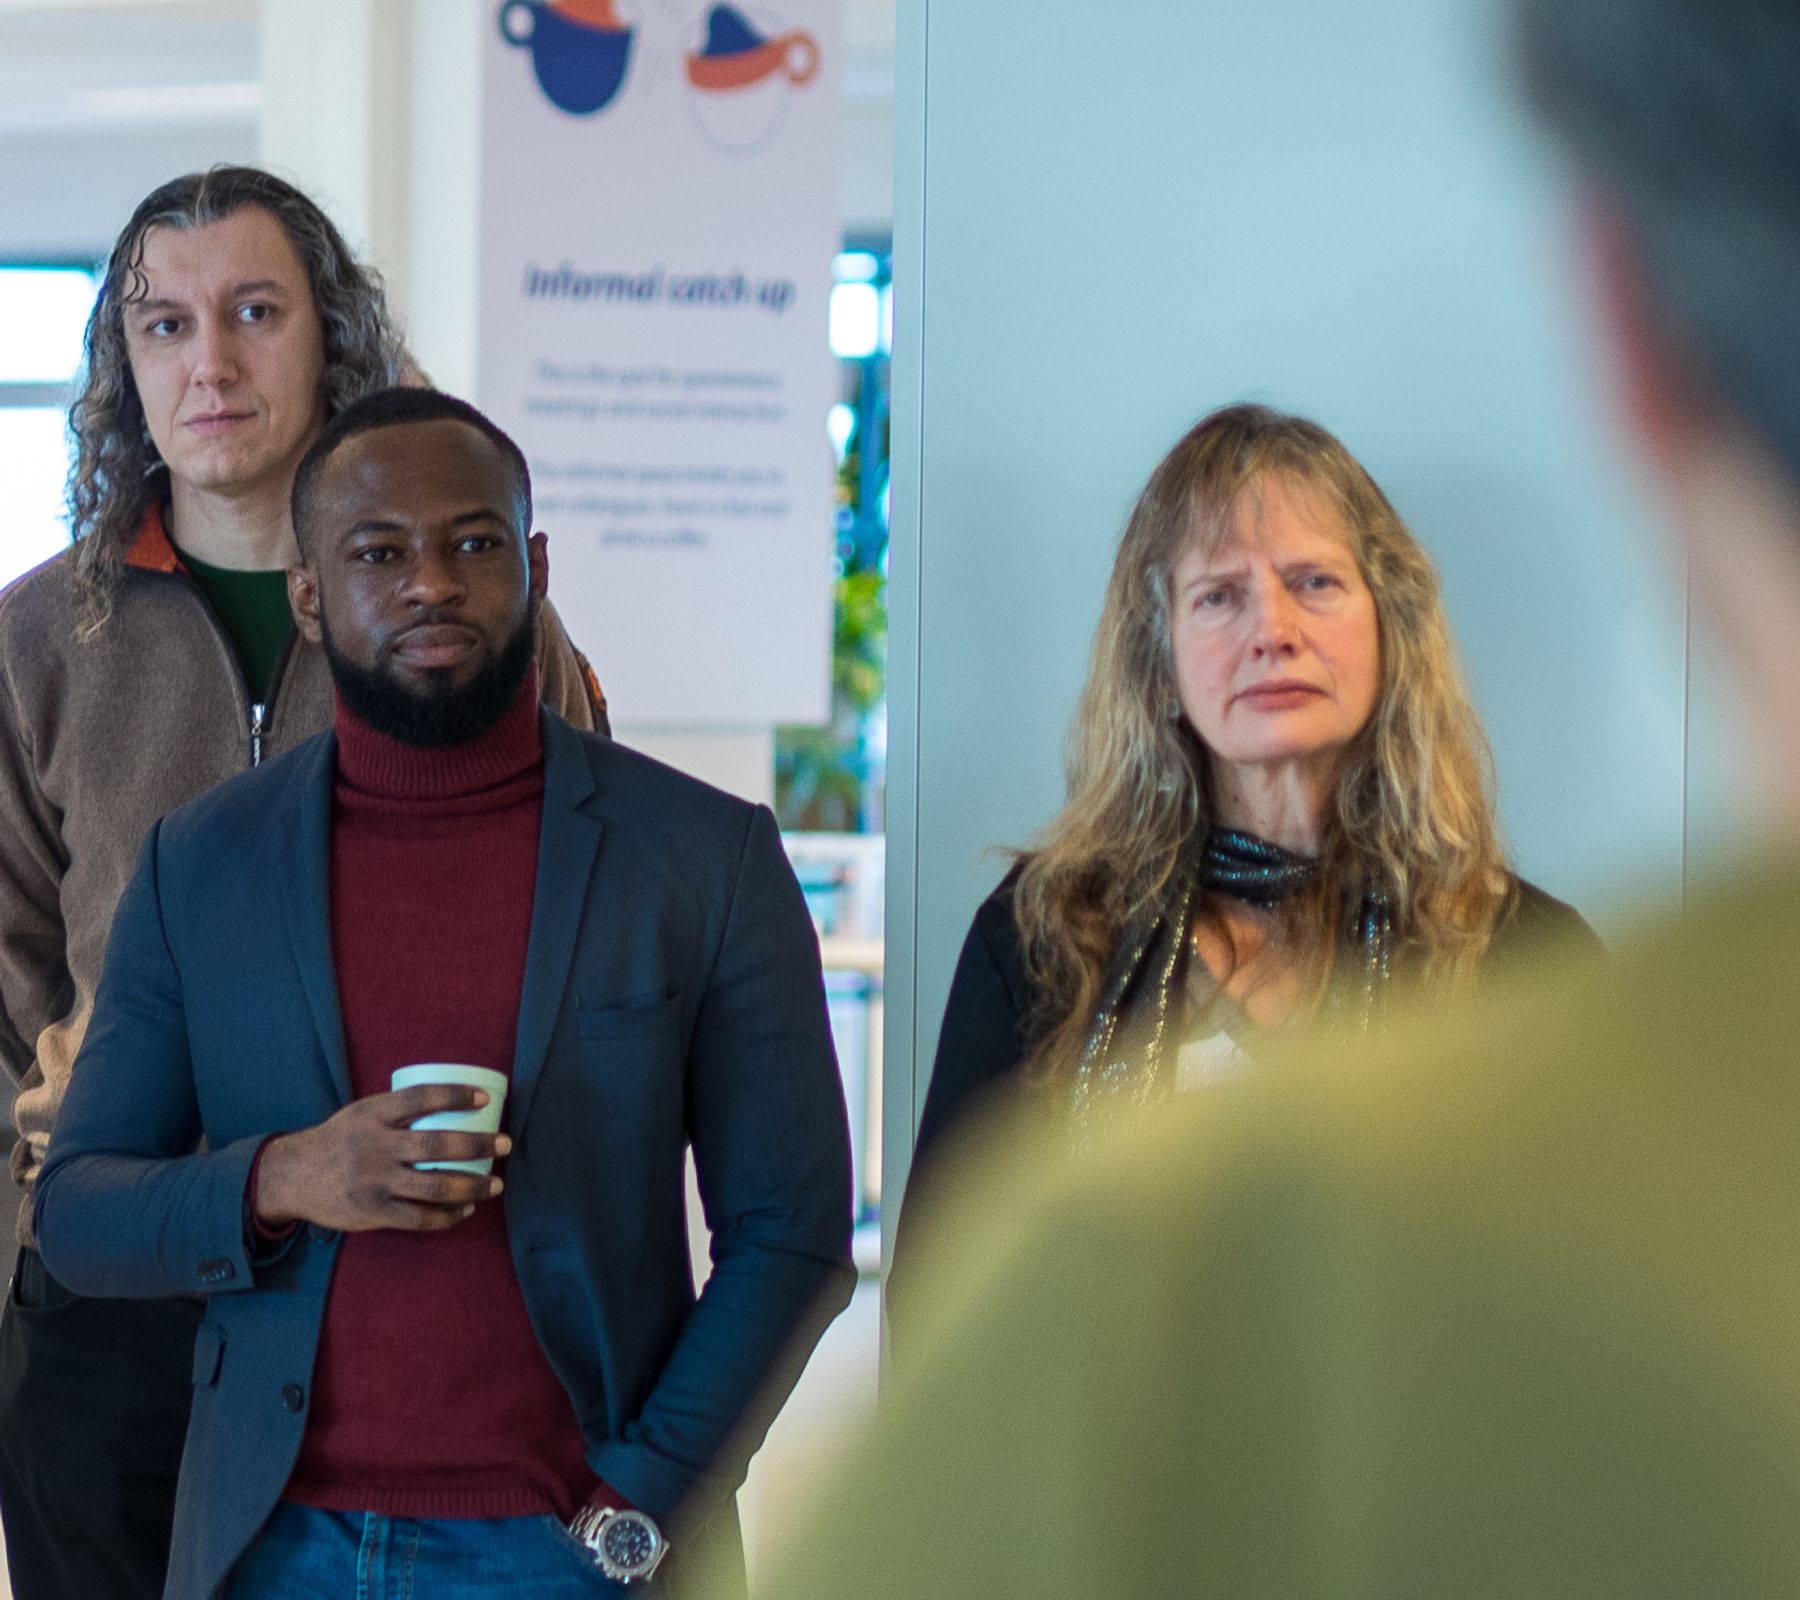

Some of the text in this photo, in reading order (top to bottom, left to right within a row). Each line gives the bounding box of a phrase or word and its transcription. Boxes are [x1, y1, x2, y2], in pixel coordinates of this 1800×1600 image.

[525, 261, 795, 316] Informal catch up
